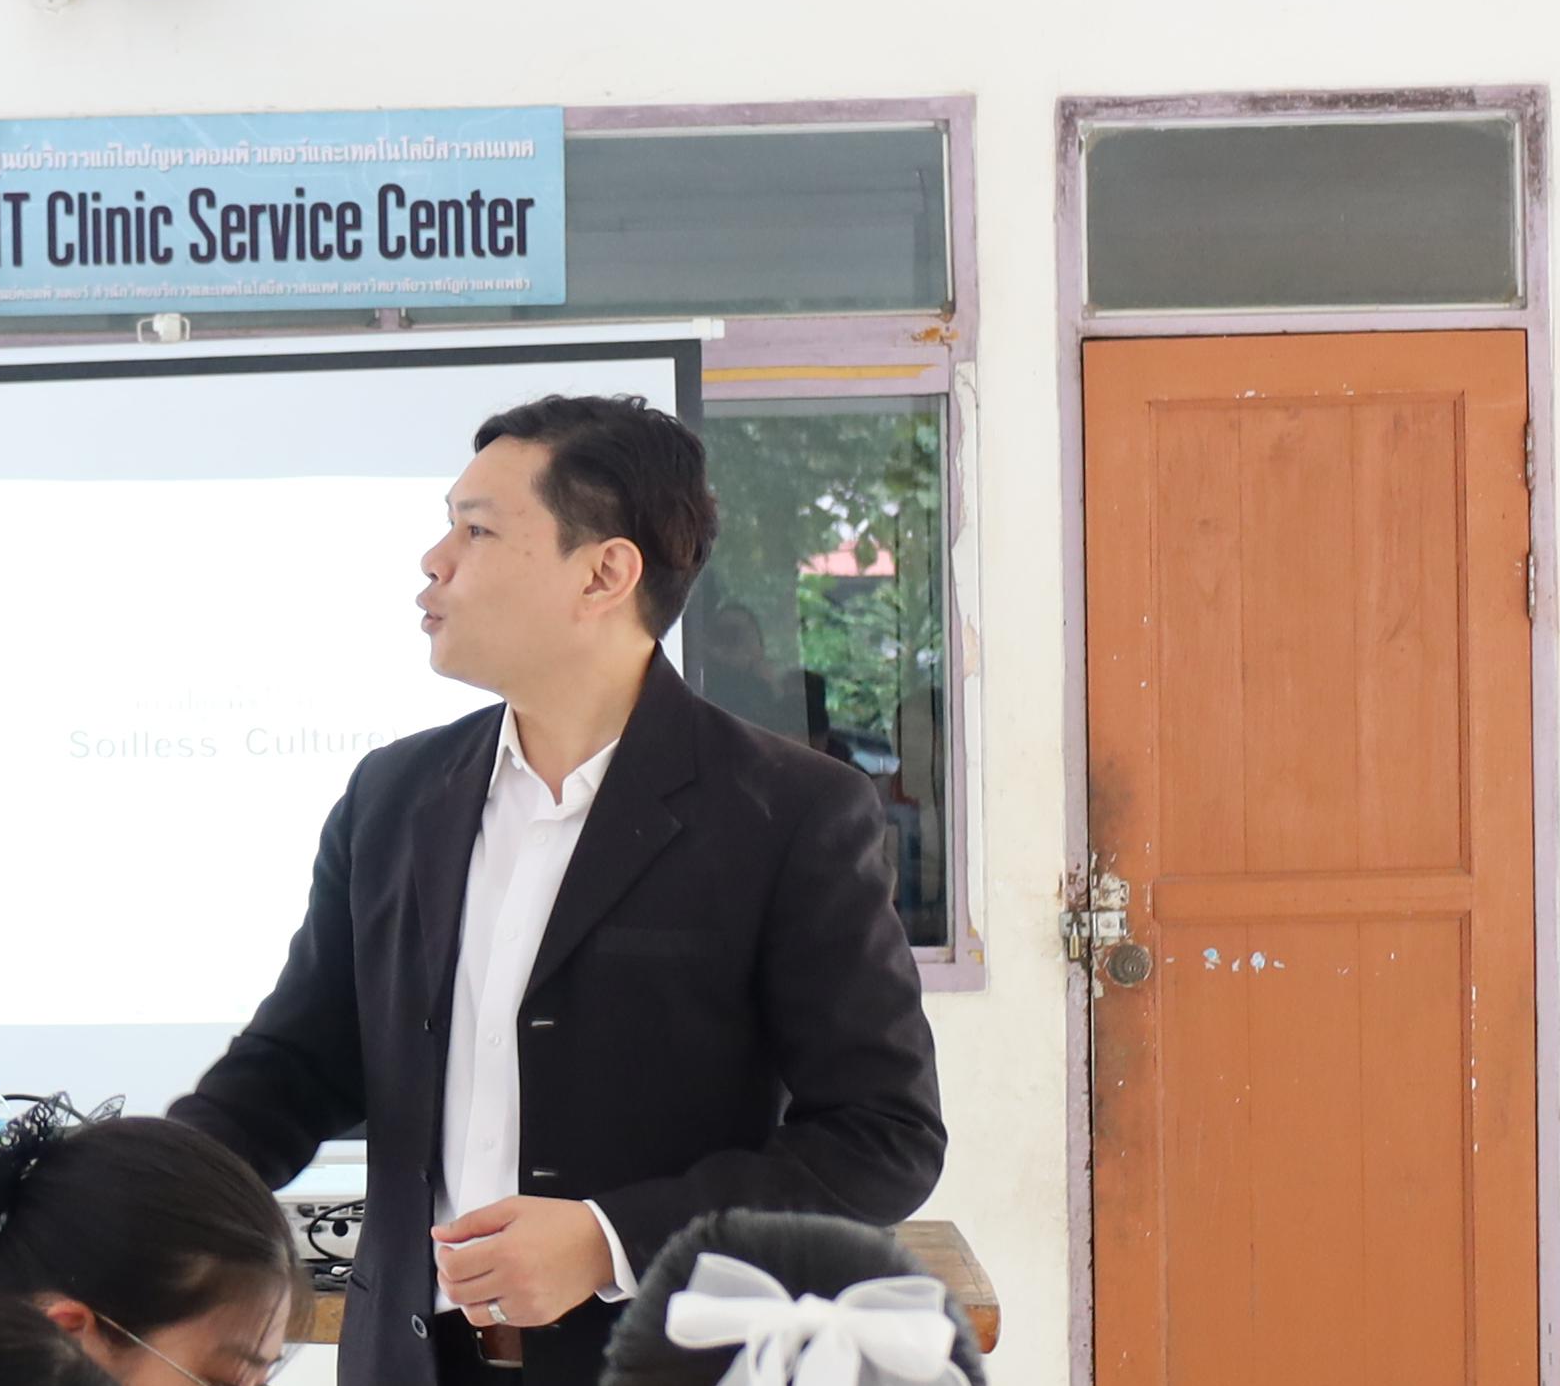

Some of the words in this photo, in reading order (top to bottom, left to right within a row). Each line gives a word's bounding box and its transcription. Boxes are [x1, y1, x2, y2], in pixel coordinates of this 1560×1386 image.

[47, 190, 173, 267] Clinic
[188, 186, 362, 265] Service
[378, 183, 536, 260] Center
[68, 730, 218, 758] Soilless
